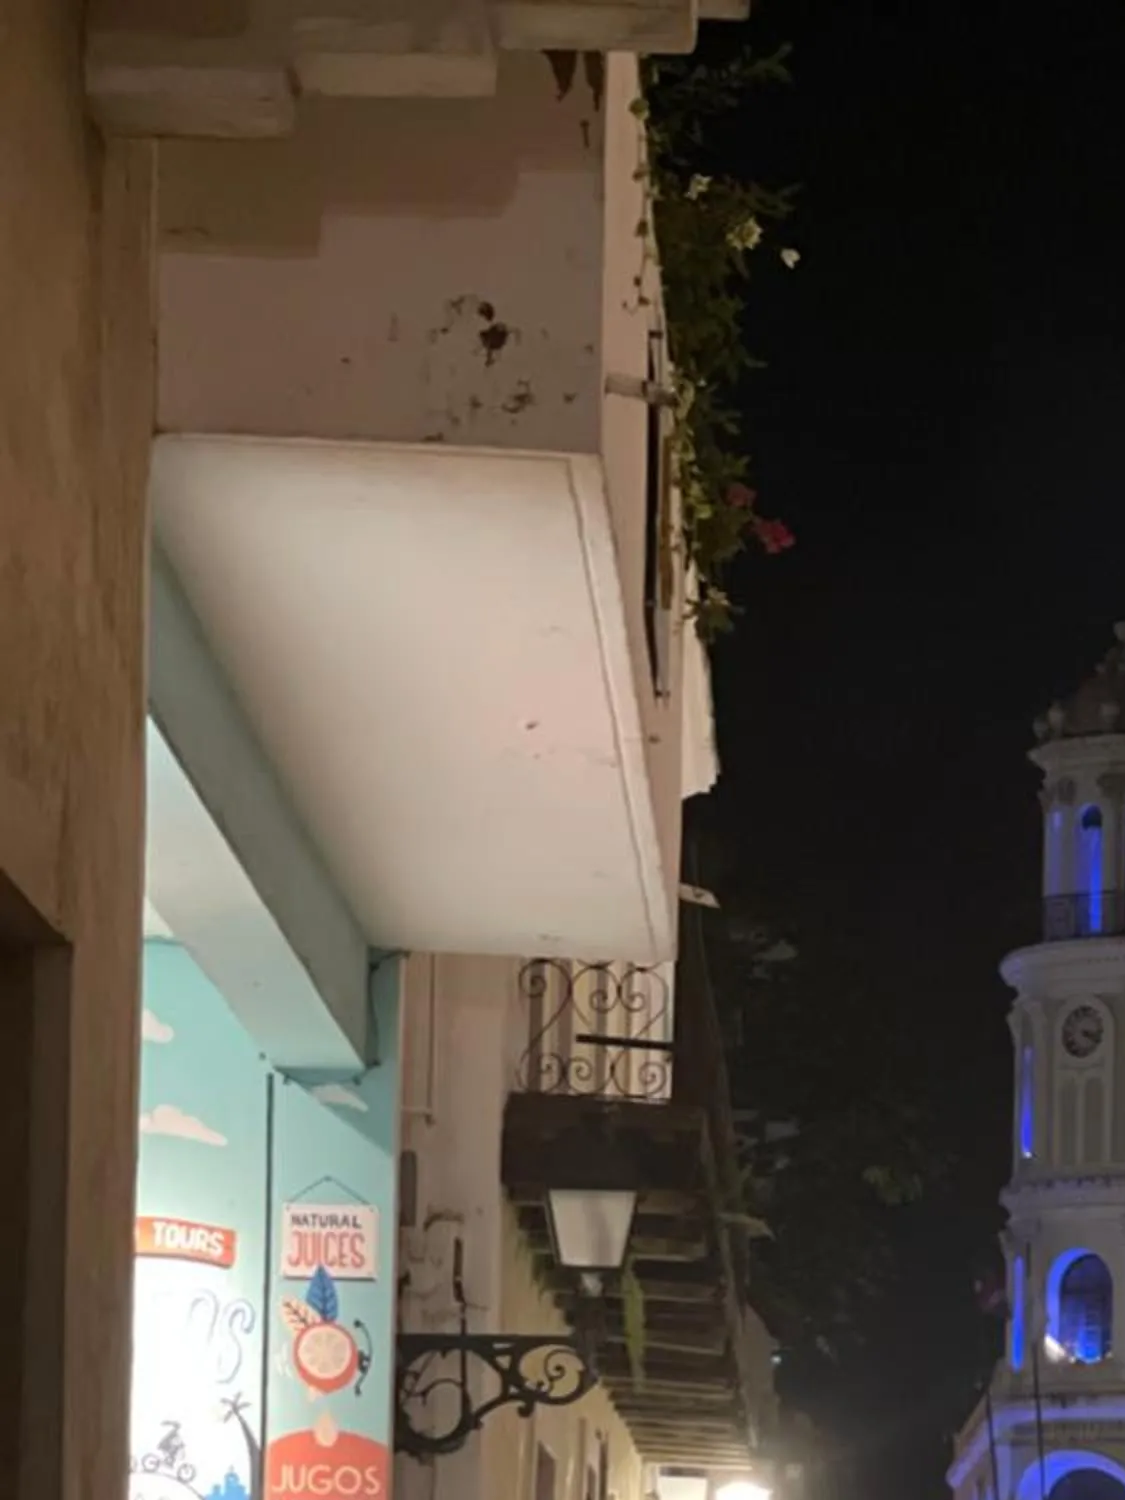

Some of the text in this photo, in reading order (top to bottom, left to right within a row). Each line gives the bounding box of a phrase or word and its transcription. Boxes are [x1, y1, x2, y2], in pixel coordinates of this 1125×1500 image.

[291, 1214, 362, 1229] NATURAL
[152, 1221, 225, 1259] TOURS
[288, 1231, 366, 1268] JUICES
[271, 1464, 380, 1495] JUGOS
